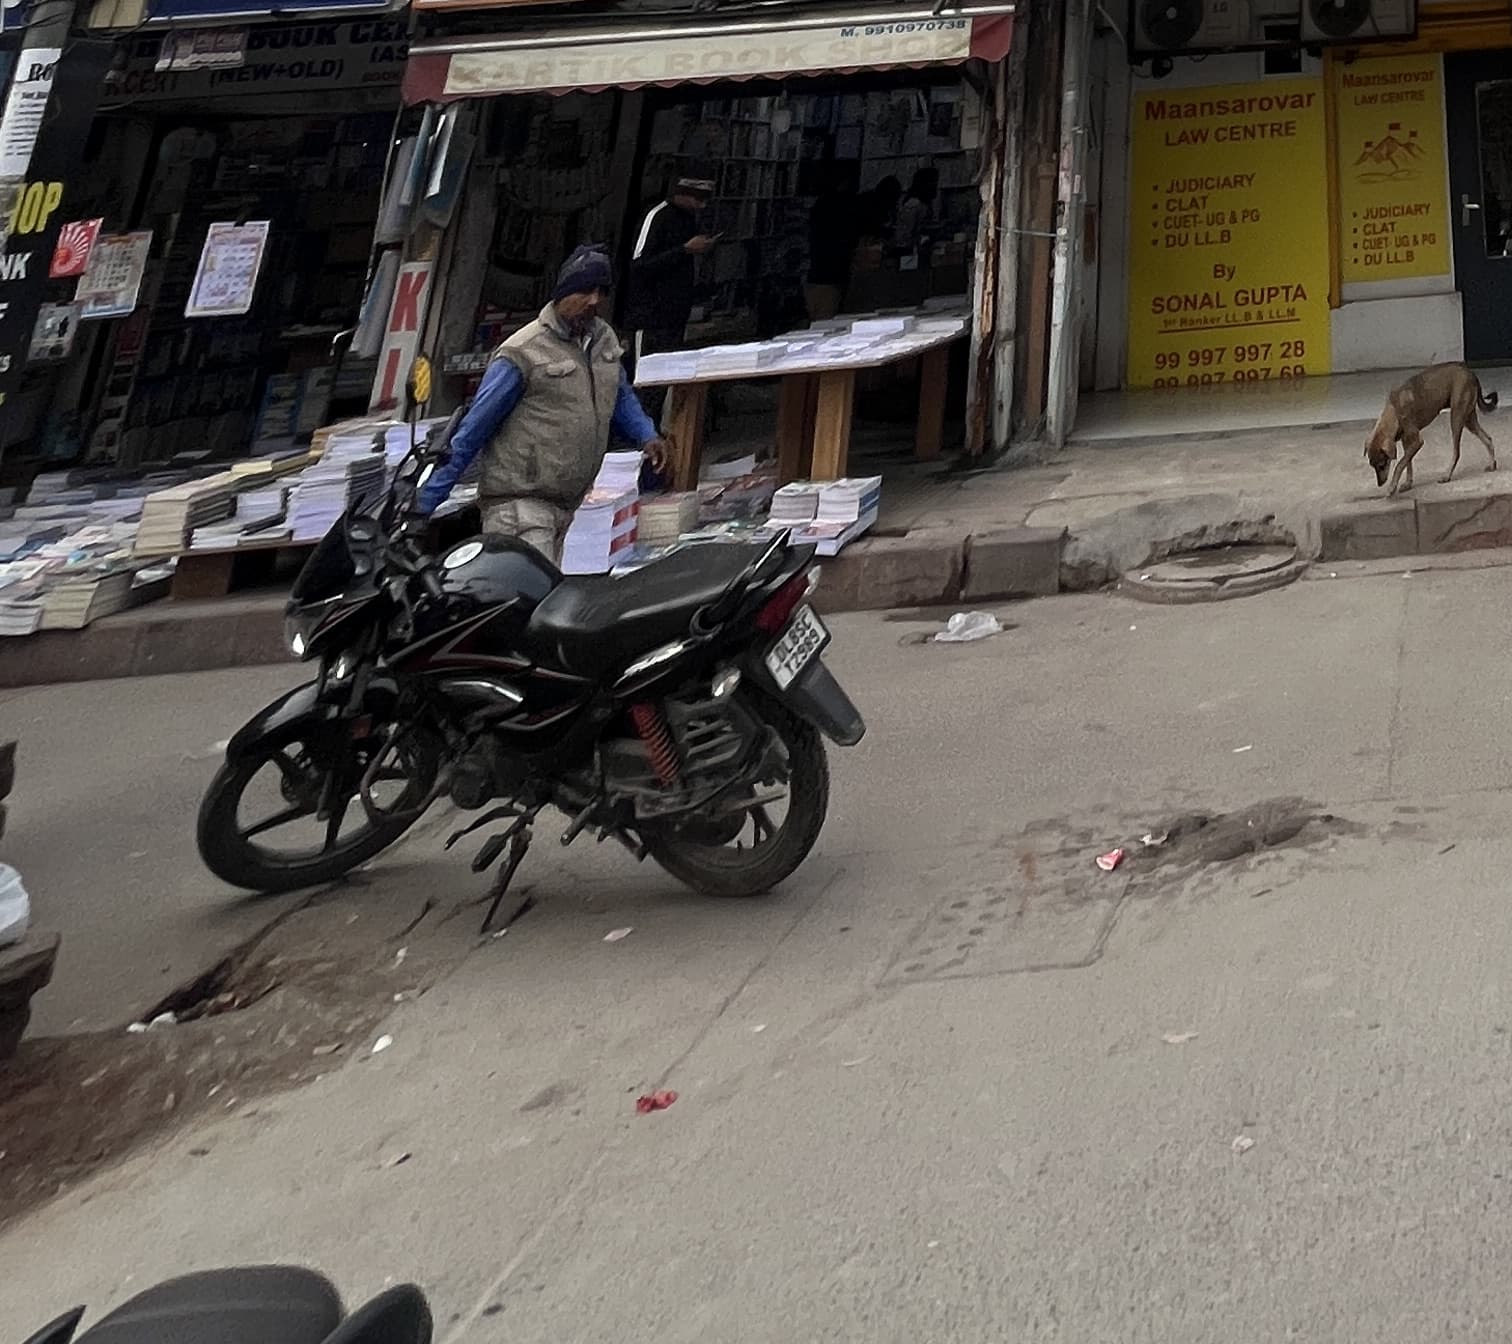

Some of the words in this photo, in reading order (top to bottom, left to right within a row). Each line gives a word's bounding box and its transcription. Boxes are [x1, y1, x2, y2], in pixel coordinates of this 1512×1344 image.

[865, 19, 969, 36] 9910970738
[452, 54, 641, 90] KARTIK
[665, 44, 814, 76] BOOK
[828, 29, 968, 64] SHOP
[209, 58, 345, 87] (NEW+OLD)
[1342, 68, 1436, 89] Maansarovar
[1144, 91, 1318, 122] Maansarovar
[1353, 92, 1379, 107] LAW
[1380, 89, 1426, 105] CENTRE
[1164, 126, 1210, 148] LAW
[1214, 120, 1297, 144] CENTRE
[1165, 172, 1257, 194] JUDICIARY
[1165, 195, 1209, 213] CLAT
[1362, 202, 1431, 221] JUDICIARY
[1206, 211, 1226, 227] UG
[1241, 208, 1262, 224] PG
[1363, 220, 1398, 236] CLAT
[1164, 232, 1189, 249] DU
[1194, 229, 1232, 246] LL.B
[1393, 233, 1411, 249] UG
[1421, 232, 1437, 247] PG
[1363, 252, 1383, 267] DU
[1212, 263, 1237, 283] By
[1151, 291, 1227, 316] SONAL
[1233, 283, 1308, 308] GUPTA
[1178, 315, 1222, 328] Ranker
[1154, 351, 1181, 371] 99
[1187, 347, 1227, 368] 997
[1233, 342, 1273, 364] 997
[1279, 339, 1306, 359] 28
